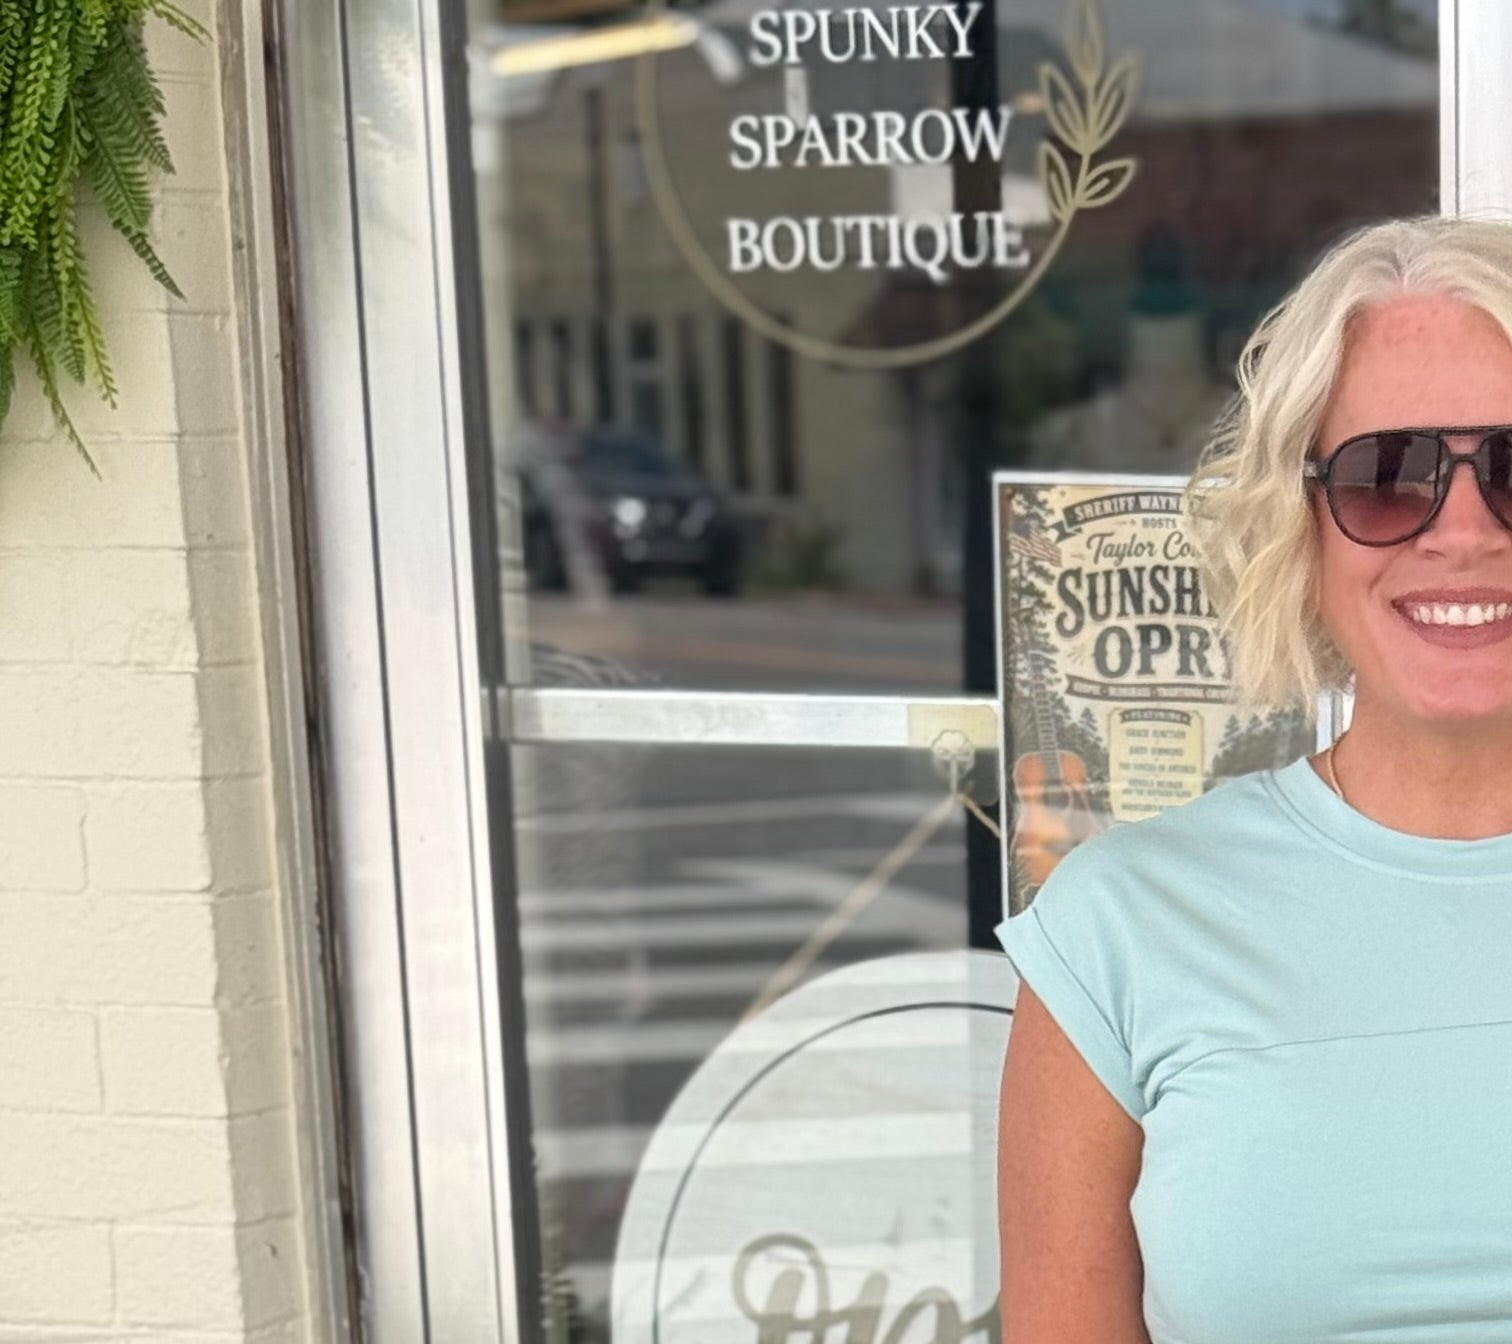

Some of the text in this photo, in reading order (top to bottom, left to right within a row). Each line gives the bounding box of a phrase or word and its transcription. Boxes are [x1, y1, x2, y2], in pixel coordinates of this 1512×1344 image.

[750, 2, 983, 65] SPUNKY
[729, 106, 1014, 169] SPARROW
[727, 210, 1030, 284] BOUTIQUE
[1074, 494, 1183, 521] SHERIFF WAYN
[1141, 518, 1178, 529] HOSTS
[1086, 531, 1198, 566] Taylor Co
[1056, 564, 1218, 637] SUNSH
